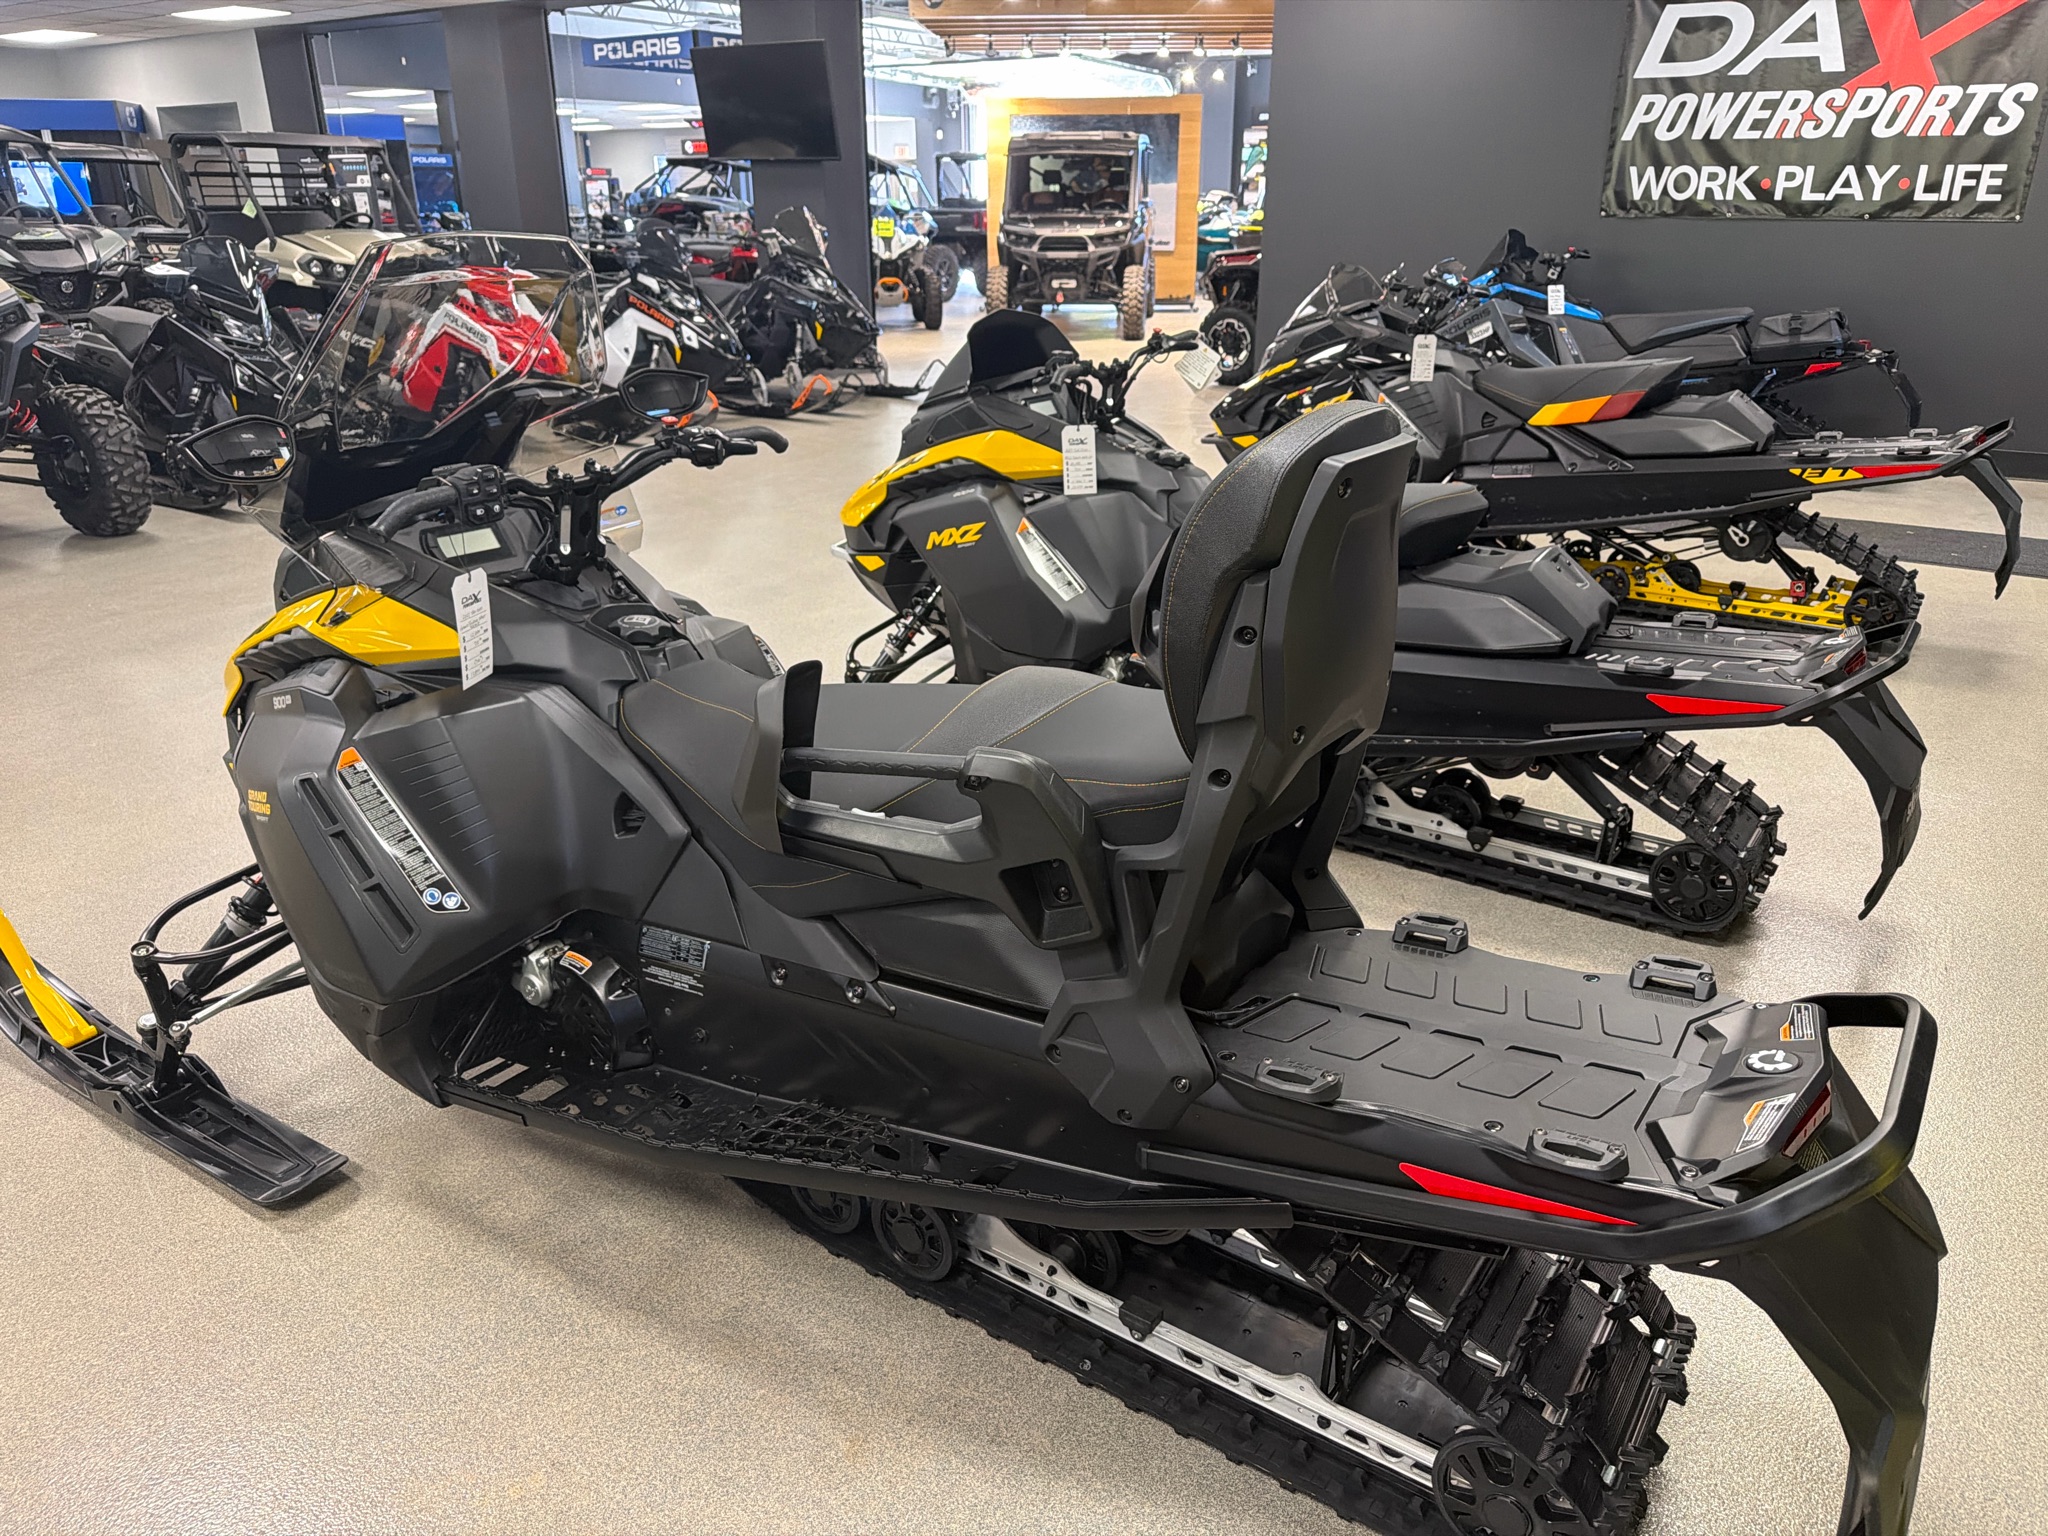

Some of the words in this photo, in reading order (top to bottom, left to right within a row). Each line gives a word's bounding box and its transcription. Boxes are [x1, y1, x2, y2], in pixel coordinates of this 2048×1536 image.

[593, 36, 682, 61] POLARIS
[1633, 0, 2028, 100] DAX
[1621, 82, 2039, 141] POWERSPORTS
[412, 156, 447, 164] POLARIS
[1629, 166, 1760, 201] WORK
[1774, 165, 1901, 201] PLAY
[1914, 164, 2008, 201] LIFE
[628, 294, 676, 329] POLARIS
[443, 311, 488, 345] POLARIS
[926, 521, 987, 550] MXZ
[461, 590, 482, 605] DAX
[248, 789, 268, 803] GRAND
